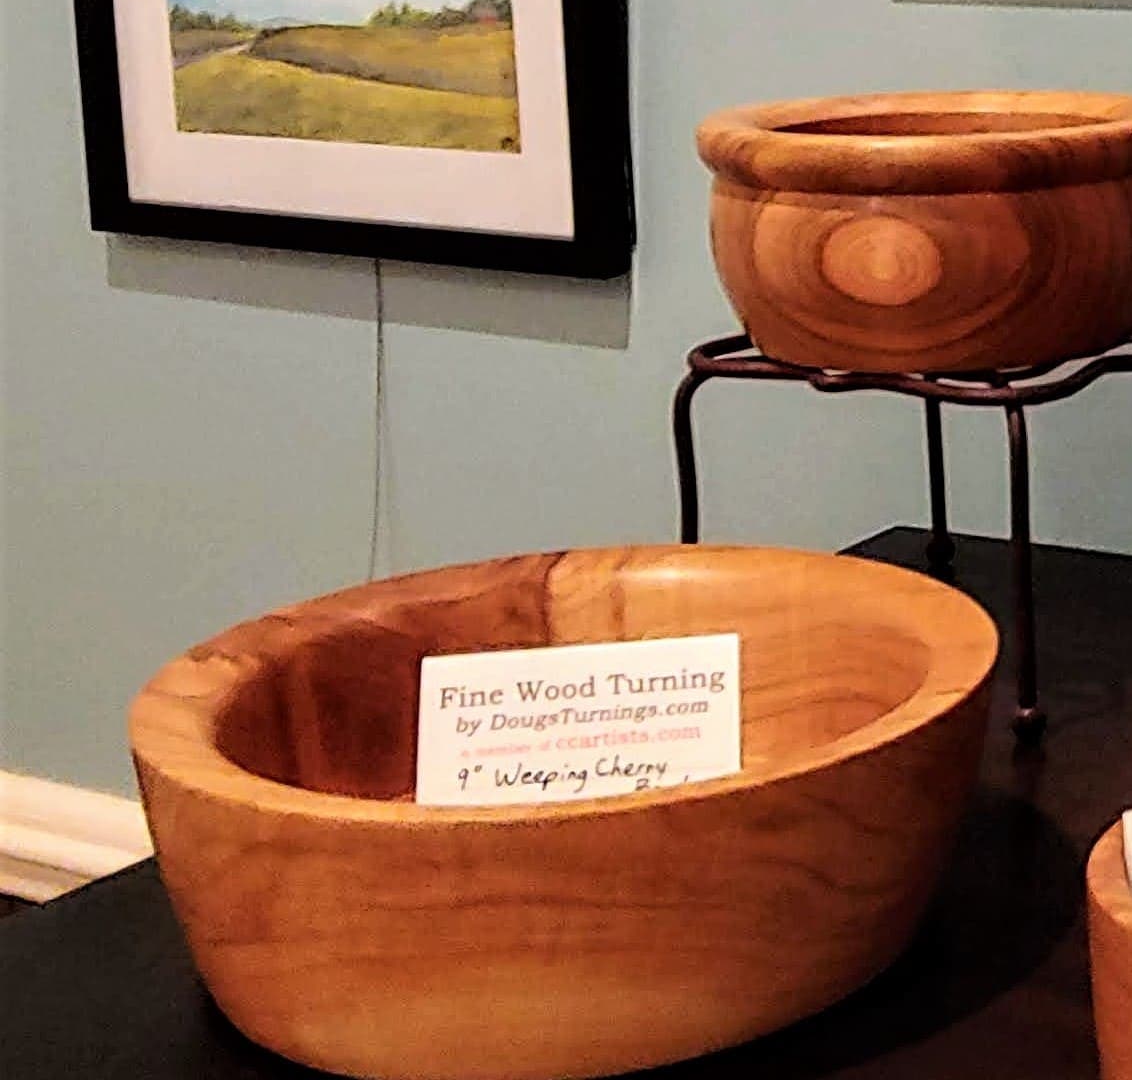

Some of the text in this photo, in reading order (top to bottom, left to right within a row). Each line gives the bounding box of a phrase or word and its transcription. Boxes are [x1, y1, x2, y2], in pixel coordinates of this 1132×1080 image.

[439, 668, 726, 709] Fine Wood Turning
[456, 699, 709, 737] by DougsTurnings.com
[555, 724, 701, 750] ccartists.com
[495, 763, 588, 792] Weeping
[595, 754, 667, 779] Cherry
